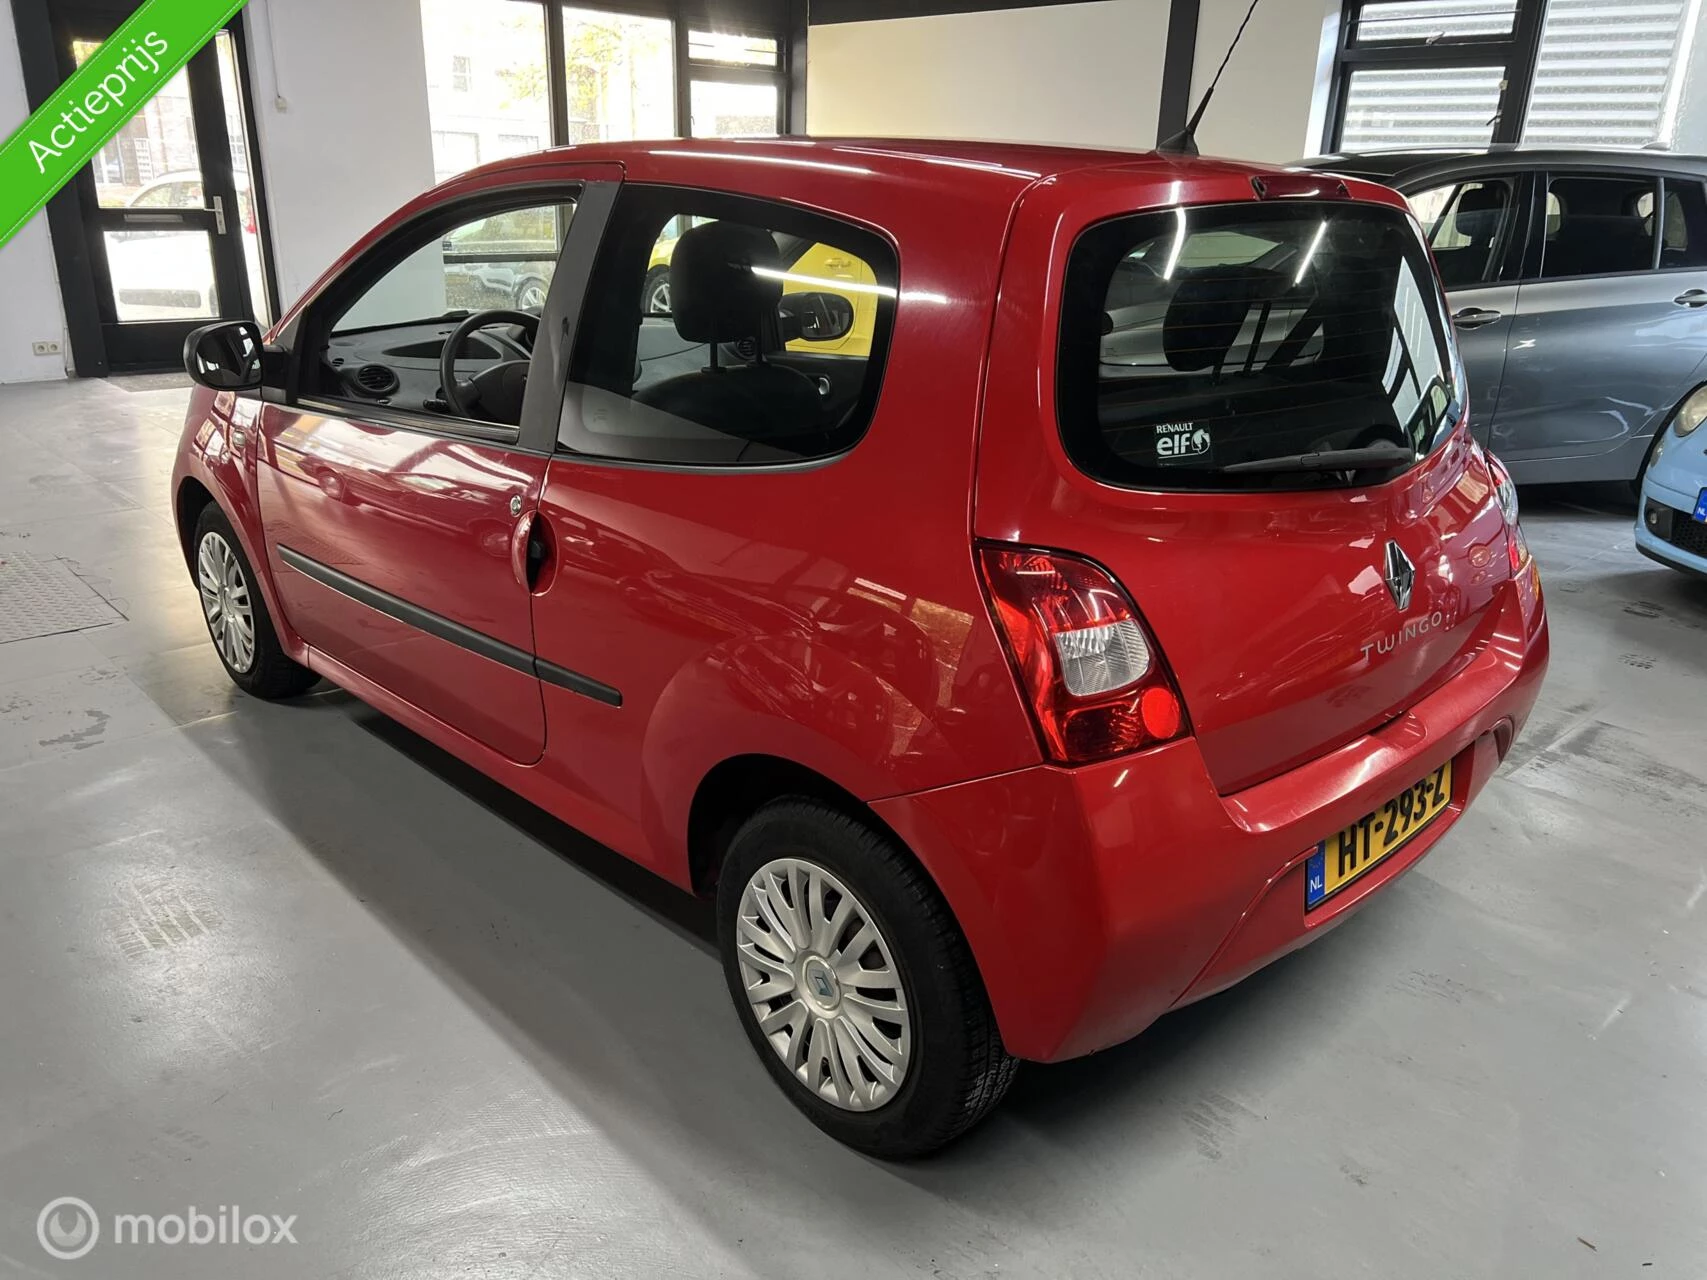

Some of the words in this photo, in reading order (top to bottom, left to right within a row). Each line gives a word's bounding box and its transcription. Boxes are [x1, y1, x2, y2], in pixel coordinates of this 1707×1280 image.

[1156, 422, 1193, 434] RENAULT
[1156, 433, 1190, 455] elf
[1360, 611, 1442, 661] TWINGO
[1338, 766, 1446, 878] HT-293-Z
[1310, 875, 1322, 893] NL
